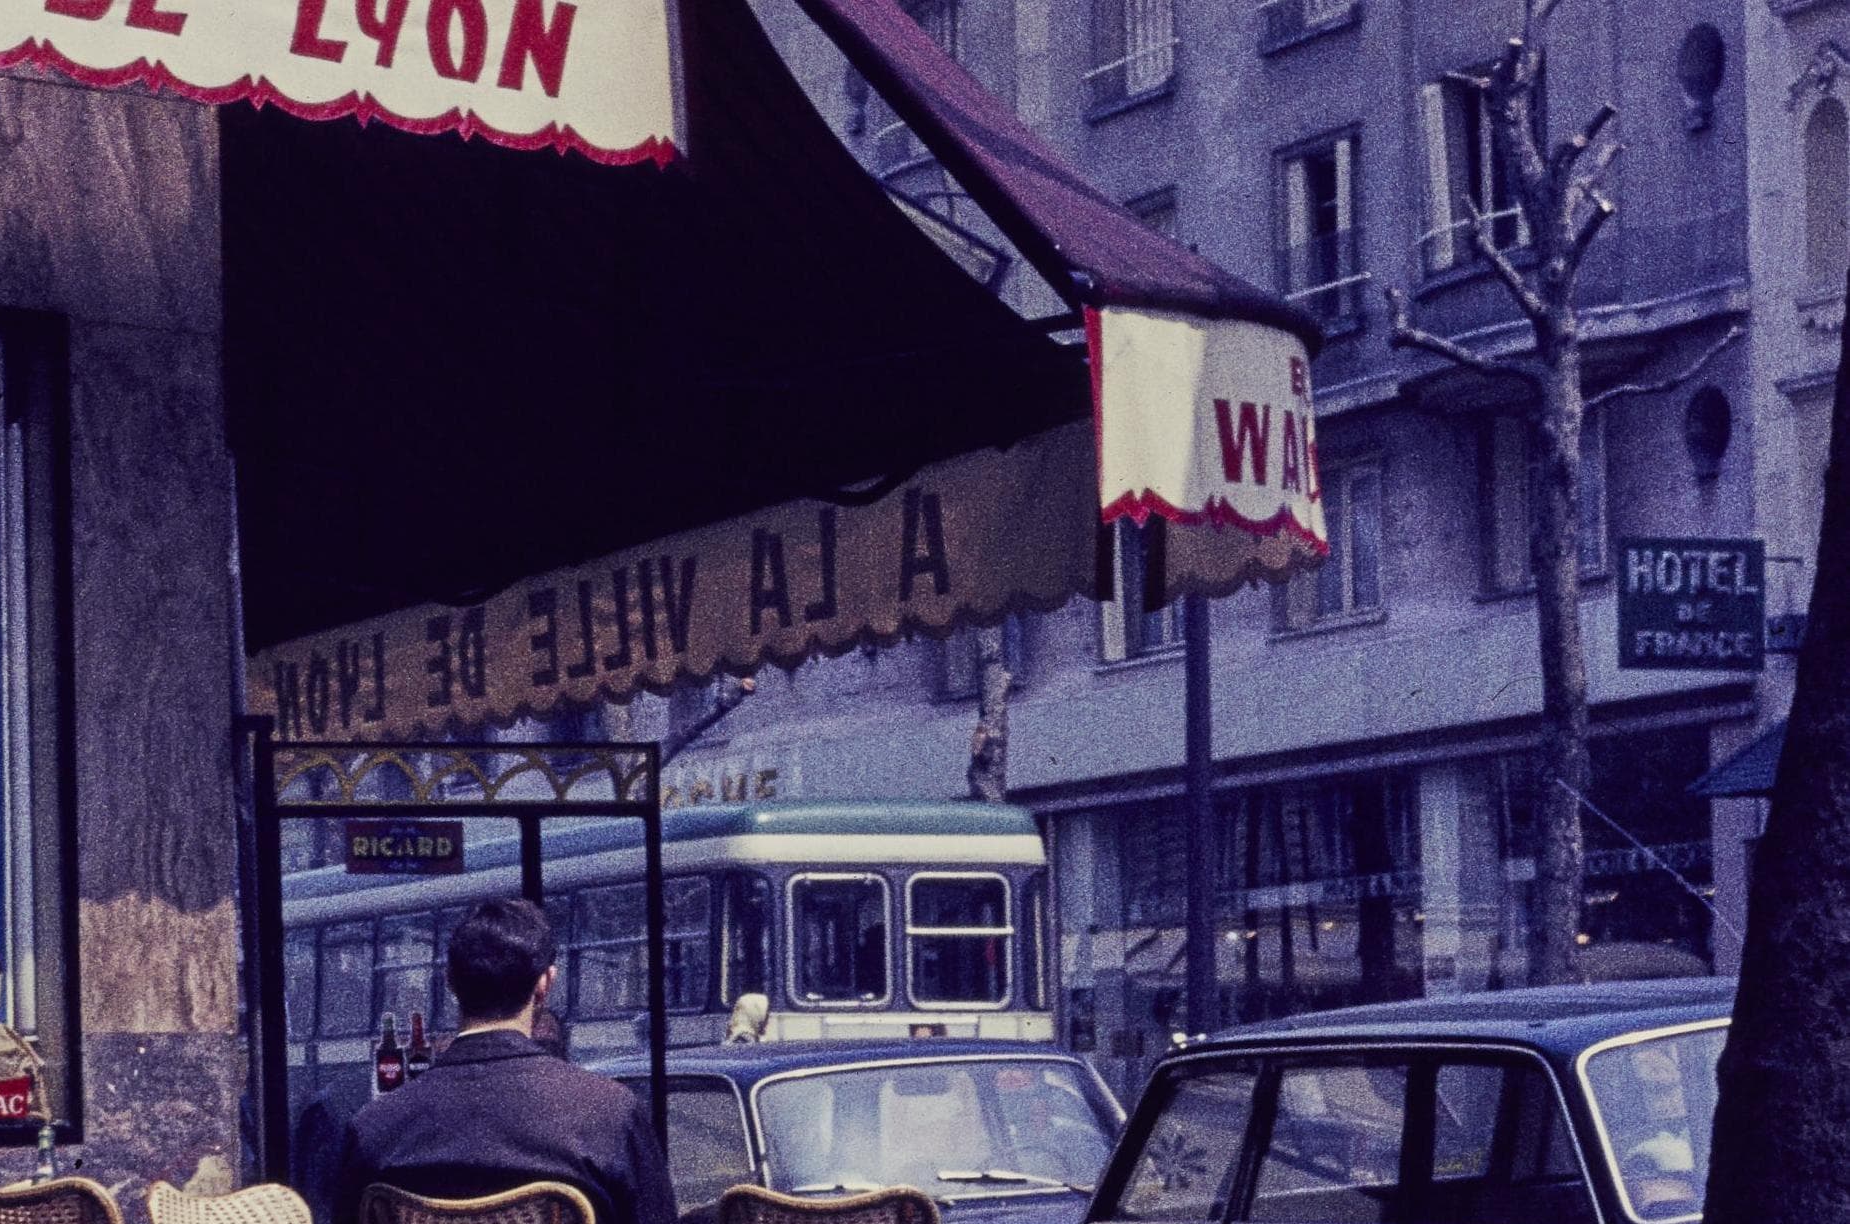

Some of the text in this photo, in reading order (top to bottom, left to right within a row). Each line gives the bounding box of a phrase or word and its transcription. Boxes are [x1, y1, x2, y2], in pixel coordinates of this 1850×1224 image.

[290, 0, 578, 99] LYON
[1627, 548, 1760, 595] HOTEL
[353, 835, 454, 857] RICARD
